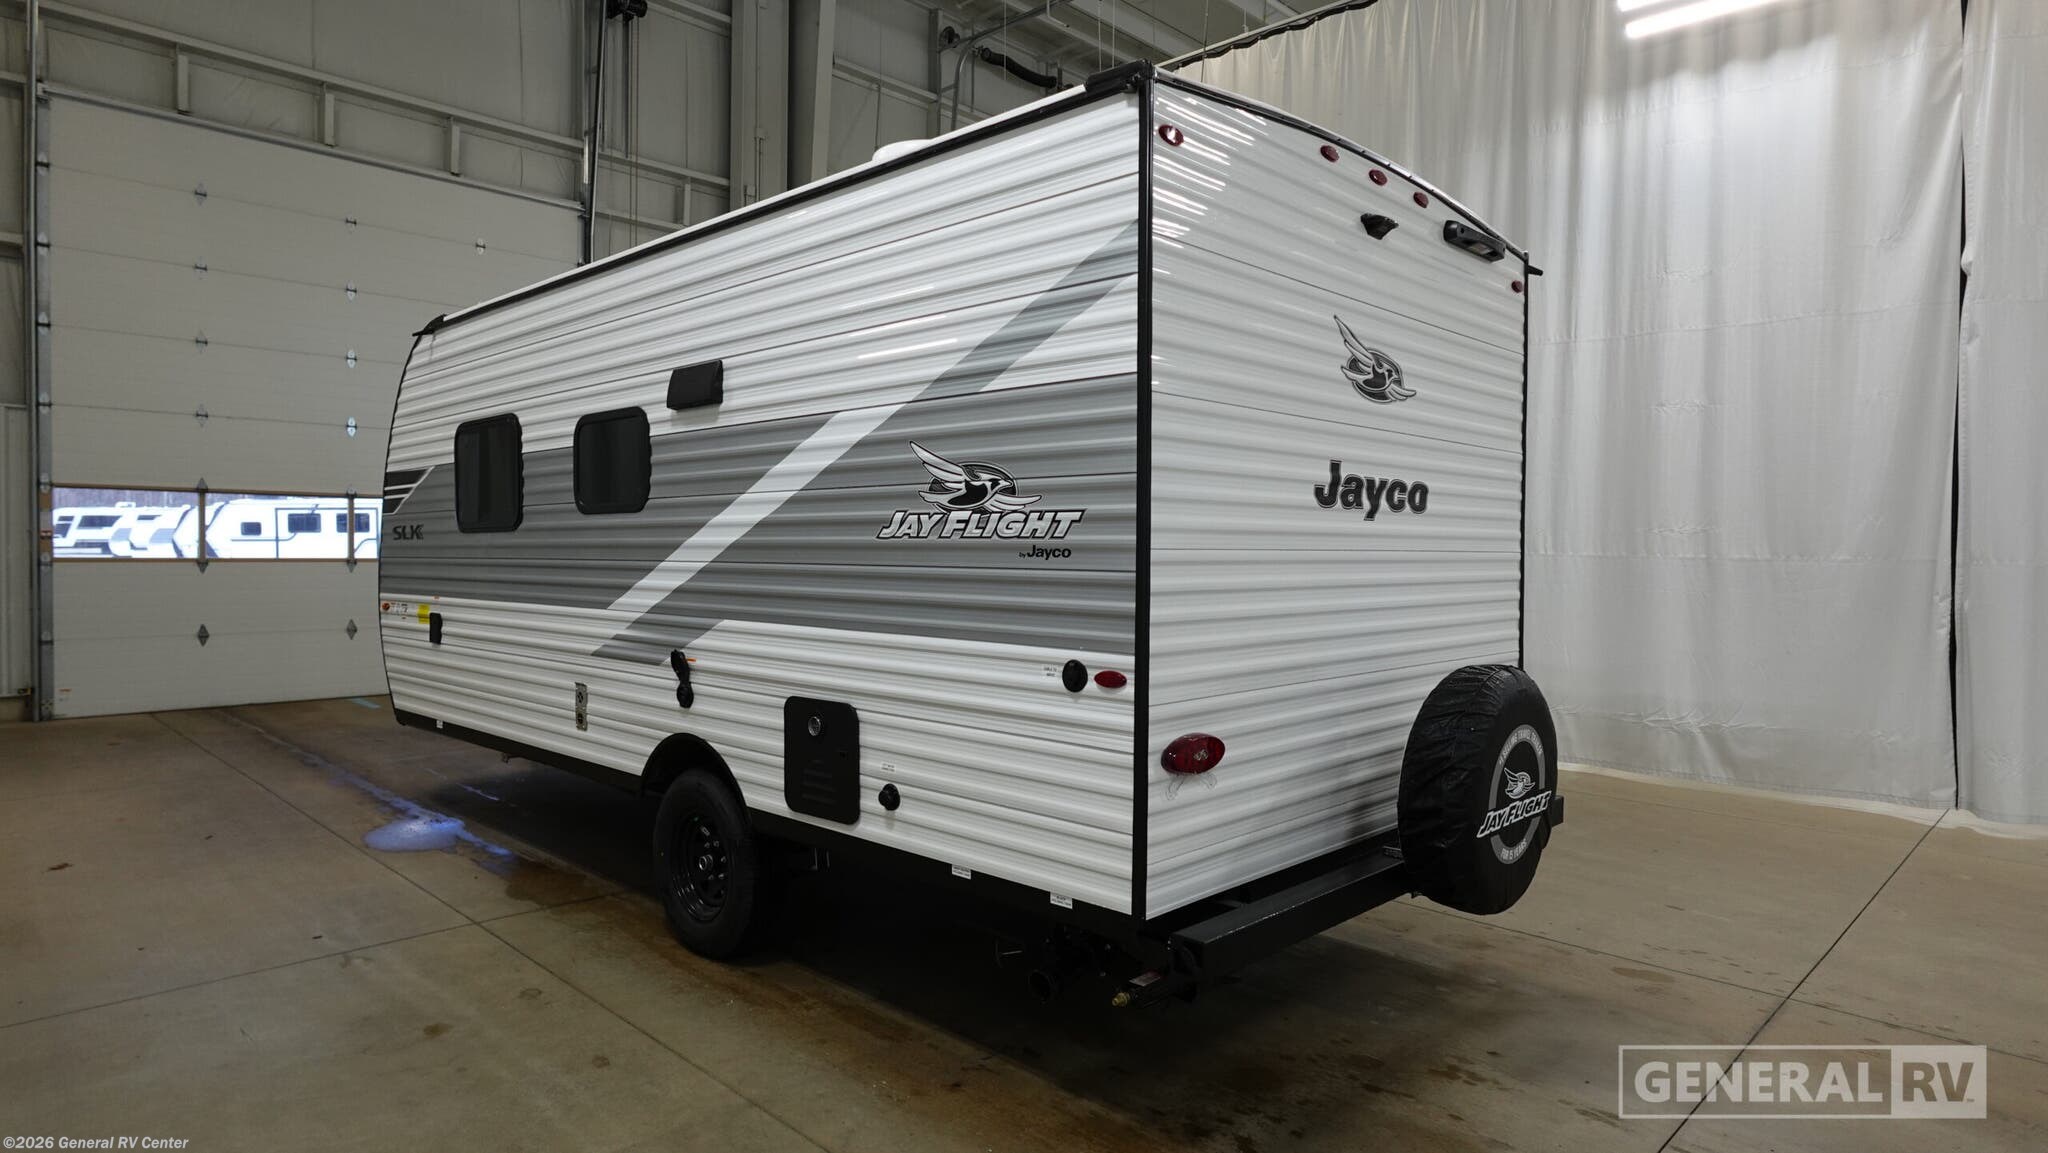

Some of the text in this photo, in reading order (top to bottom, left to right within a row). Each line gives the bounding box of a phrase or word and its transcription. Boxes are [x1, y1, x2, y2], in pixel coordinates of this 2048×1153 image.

[1314, 459, 1429, 521] Jayco
[392, 524, 424, 540] SLK
[876, 508, 1088, 540] JAY FLIGHT
[1027, 544, 1072, 560] Jayco
[1503, 790, 1552, 827] FLIGHT
